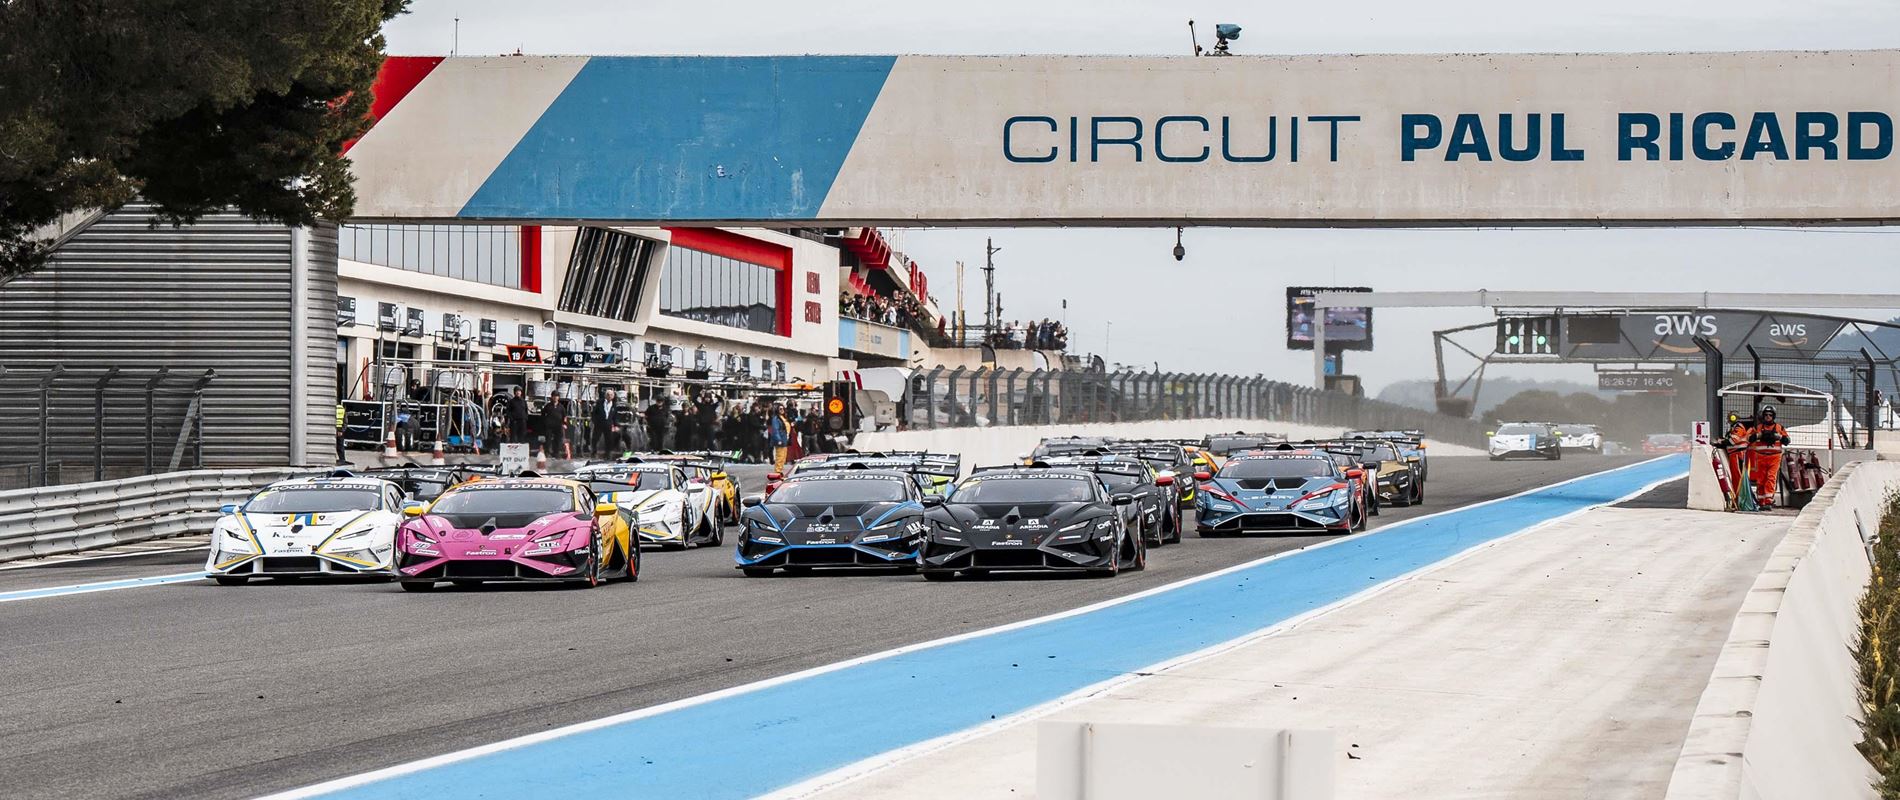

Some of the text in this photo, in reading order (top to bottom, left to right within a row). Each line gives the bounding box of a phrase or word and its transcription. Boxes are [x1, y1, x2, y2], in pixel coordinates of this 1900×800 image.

[1004, 112, 1893, 162] CIRCUIT PAUL RICARD
[1654, 315, 1718, 336] aws
[1770, 323, 1806, 336] aws
[512, 352, 521, 360] 19
[560, 357, 568, 365] 19
[972, 474, 1023, 482] ROGER
